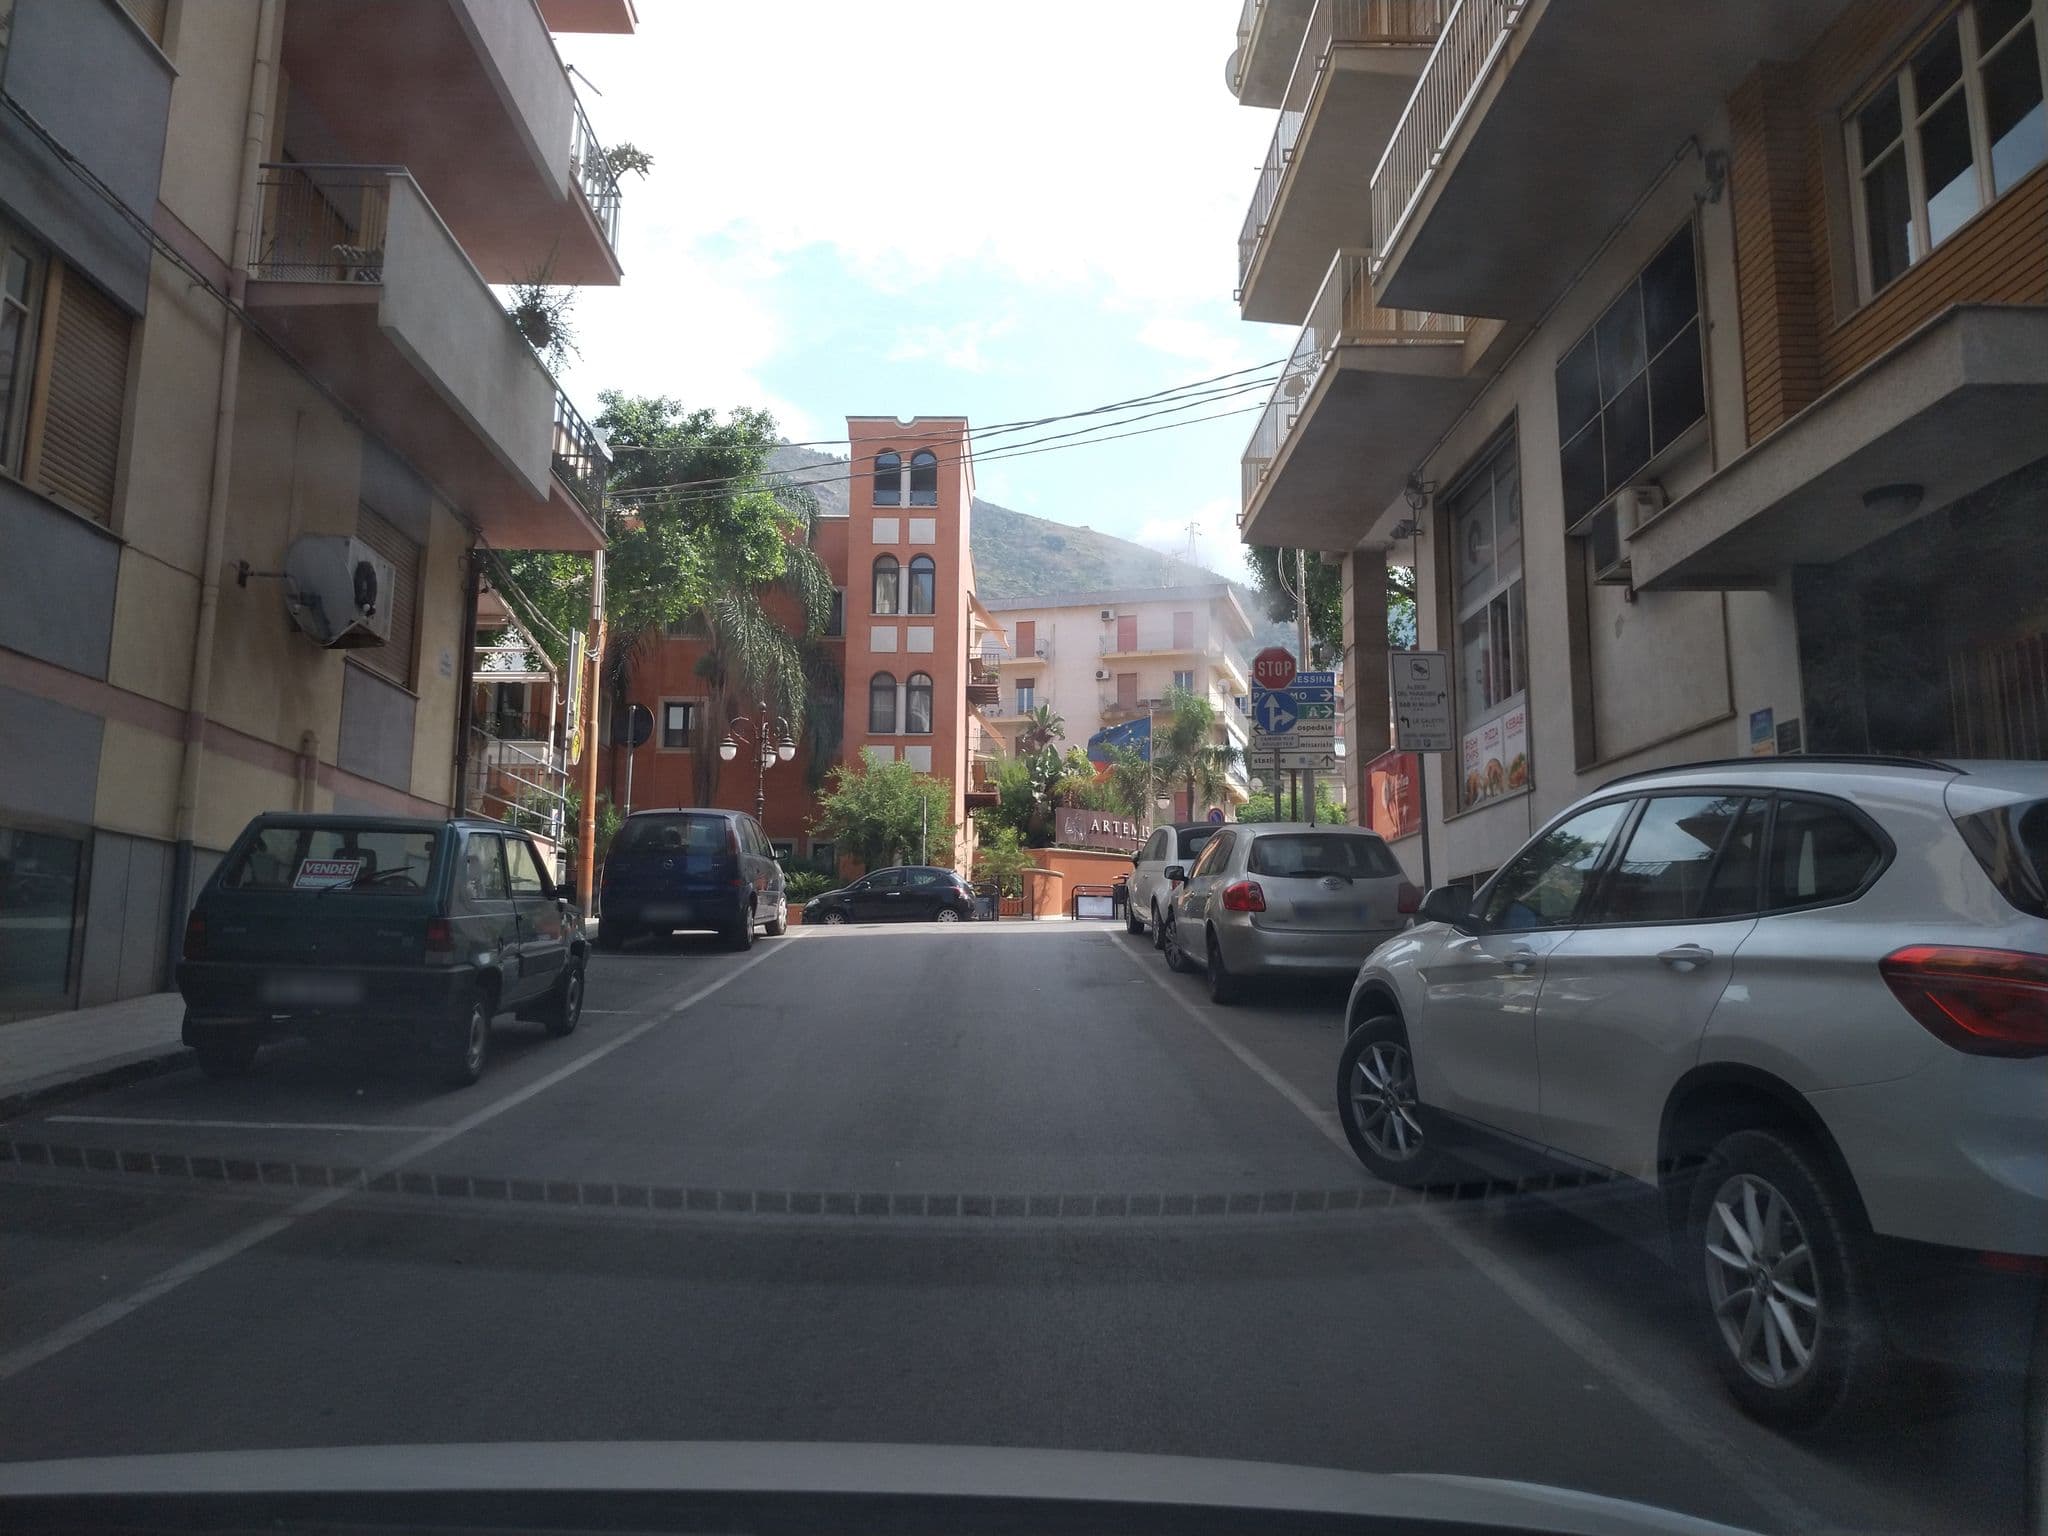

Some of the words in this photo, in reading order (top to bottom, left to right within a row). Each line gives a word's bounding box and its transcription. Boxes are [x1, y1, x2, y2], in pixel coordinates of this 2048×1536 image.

[1258, 660, 1292, 677] STOP
[1294, 675, 1333, 684] ESSINA
[1506, 712, 1524, 729] KEBAB
[1297, 724, 1333, 733] ospedale
[1484, 727, 1499, 741] PIZZA
[1465, 738, 1478, 750] FISH
[1465, 750, 1479, 762] CHIPS
[305, 862, 356, 874] VENDESI
